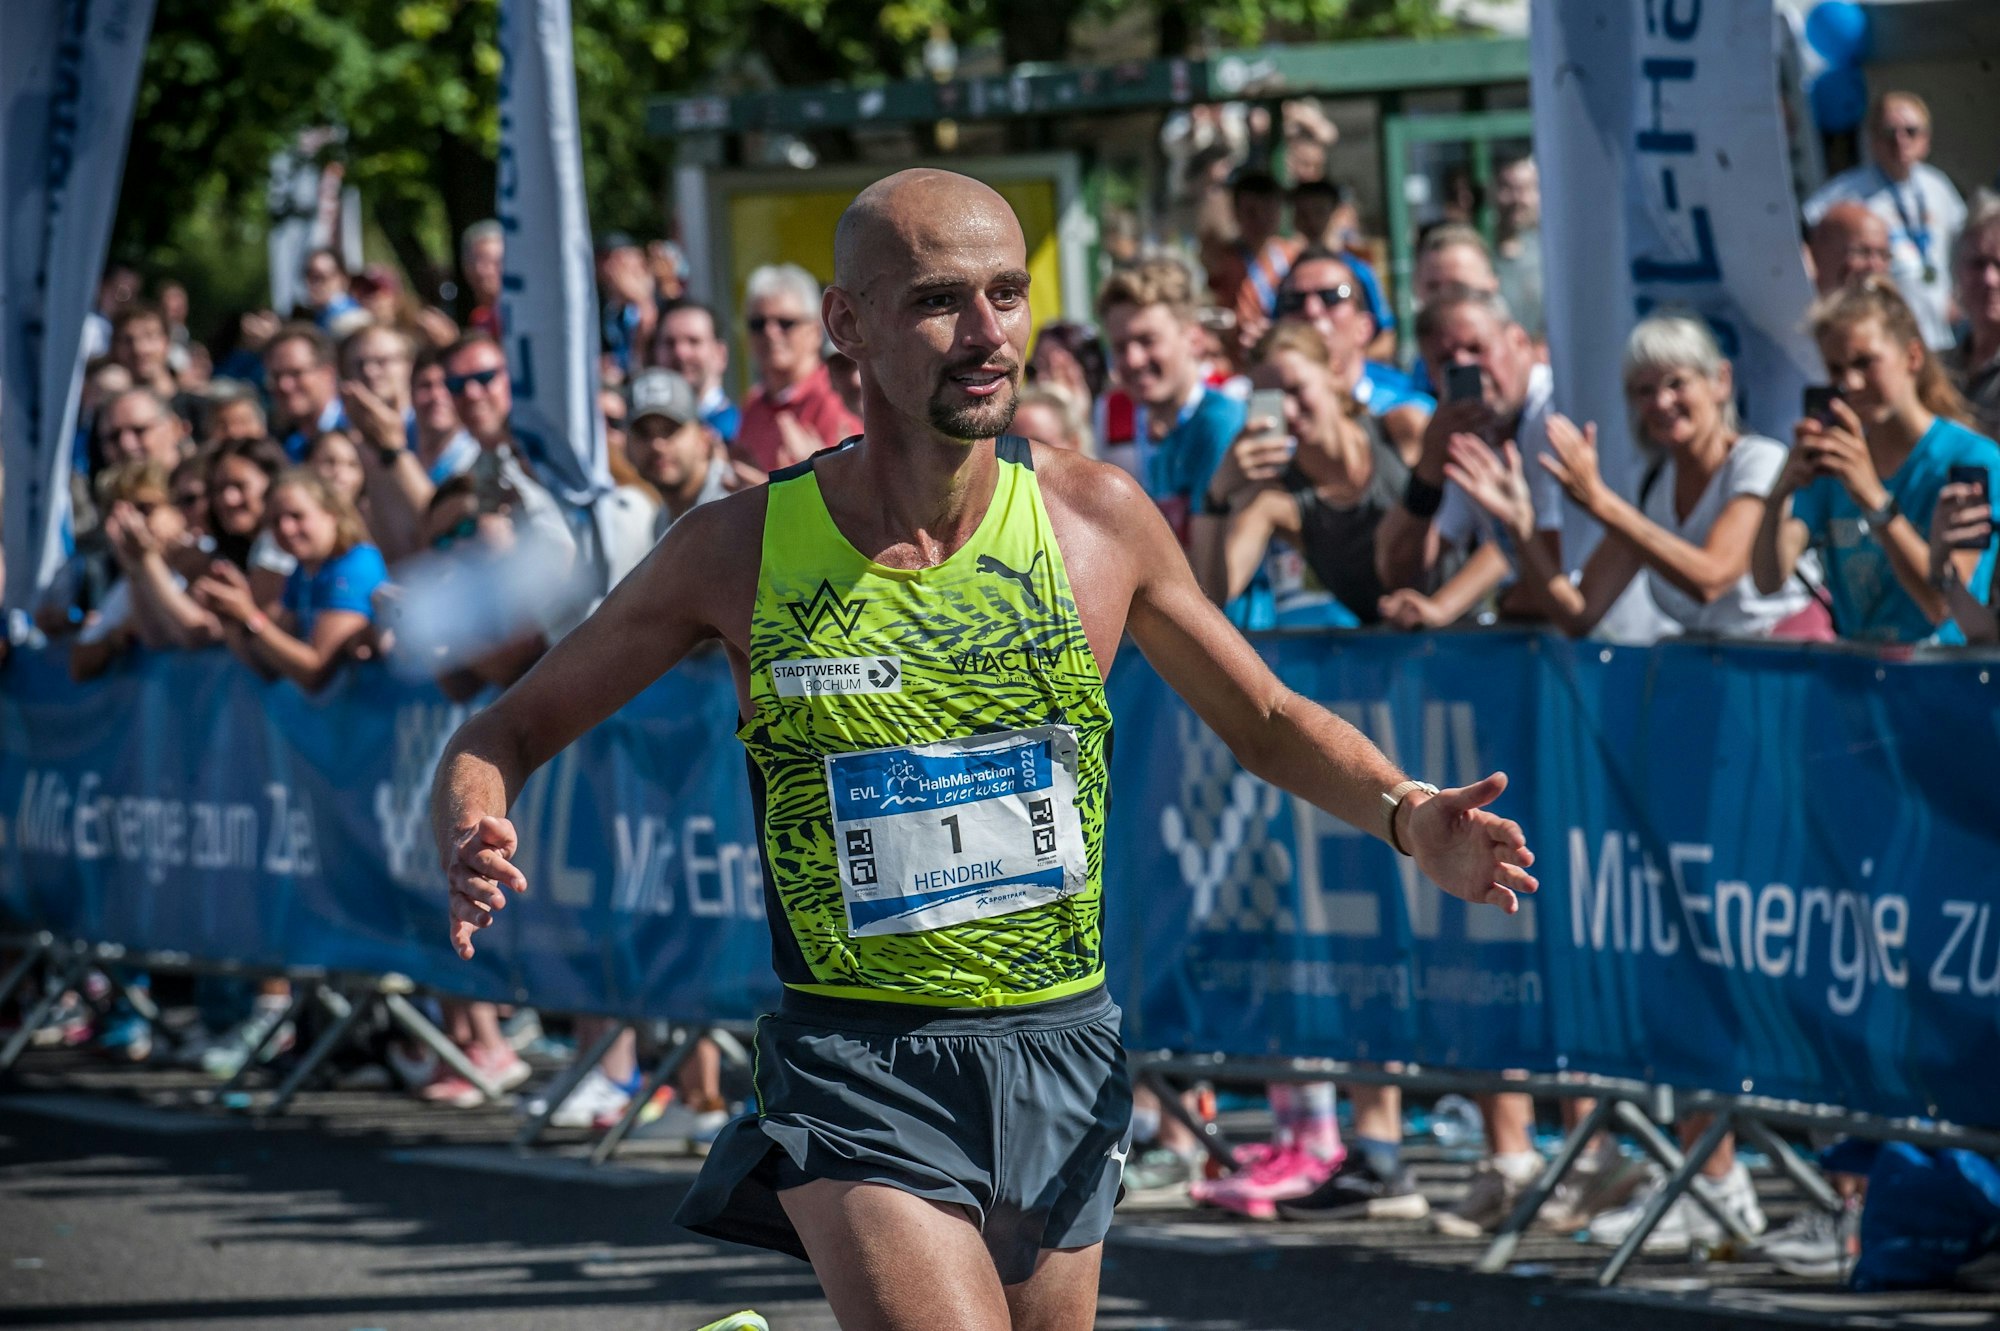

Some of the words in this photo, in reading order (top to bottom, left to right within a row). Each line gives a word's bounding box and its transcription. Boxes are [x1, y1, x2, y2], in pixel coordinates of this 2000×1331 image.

[774, 664, 861, 678] STADTWERKE
[948, 645, 1064, 677] VIACTIV
[805, 679, 862, 692] BOCHUM
[995, 673, 1067, 684] Krankeasse
[850, 786, 881, 802] EVL
[919, 765, 1016, 793] HalbMarathon
[1021, 748, 1038, 788] 2022
[936, 779, 1016, 806] Leverkusen
[940, 814, 963, 855] 1
[914, 858, 1004, 891] HENDRIK
[988, 890, 1027, 903] SPORTPARK
[1567, 826, 1680, 957] Mit
[1668, 842, 1911, 1017] Energie
